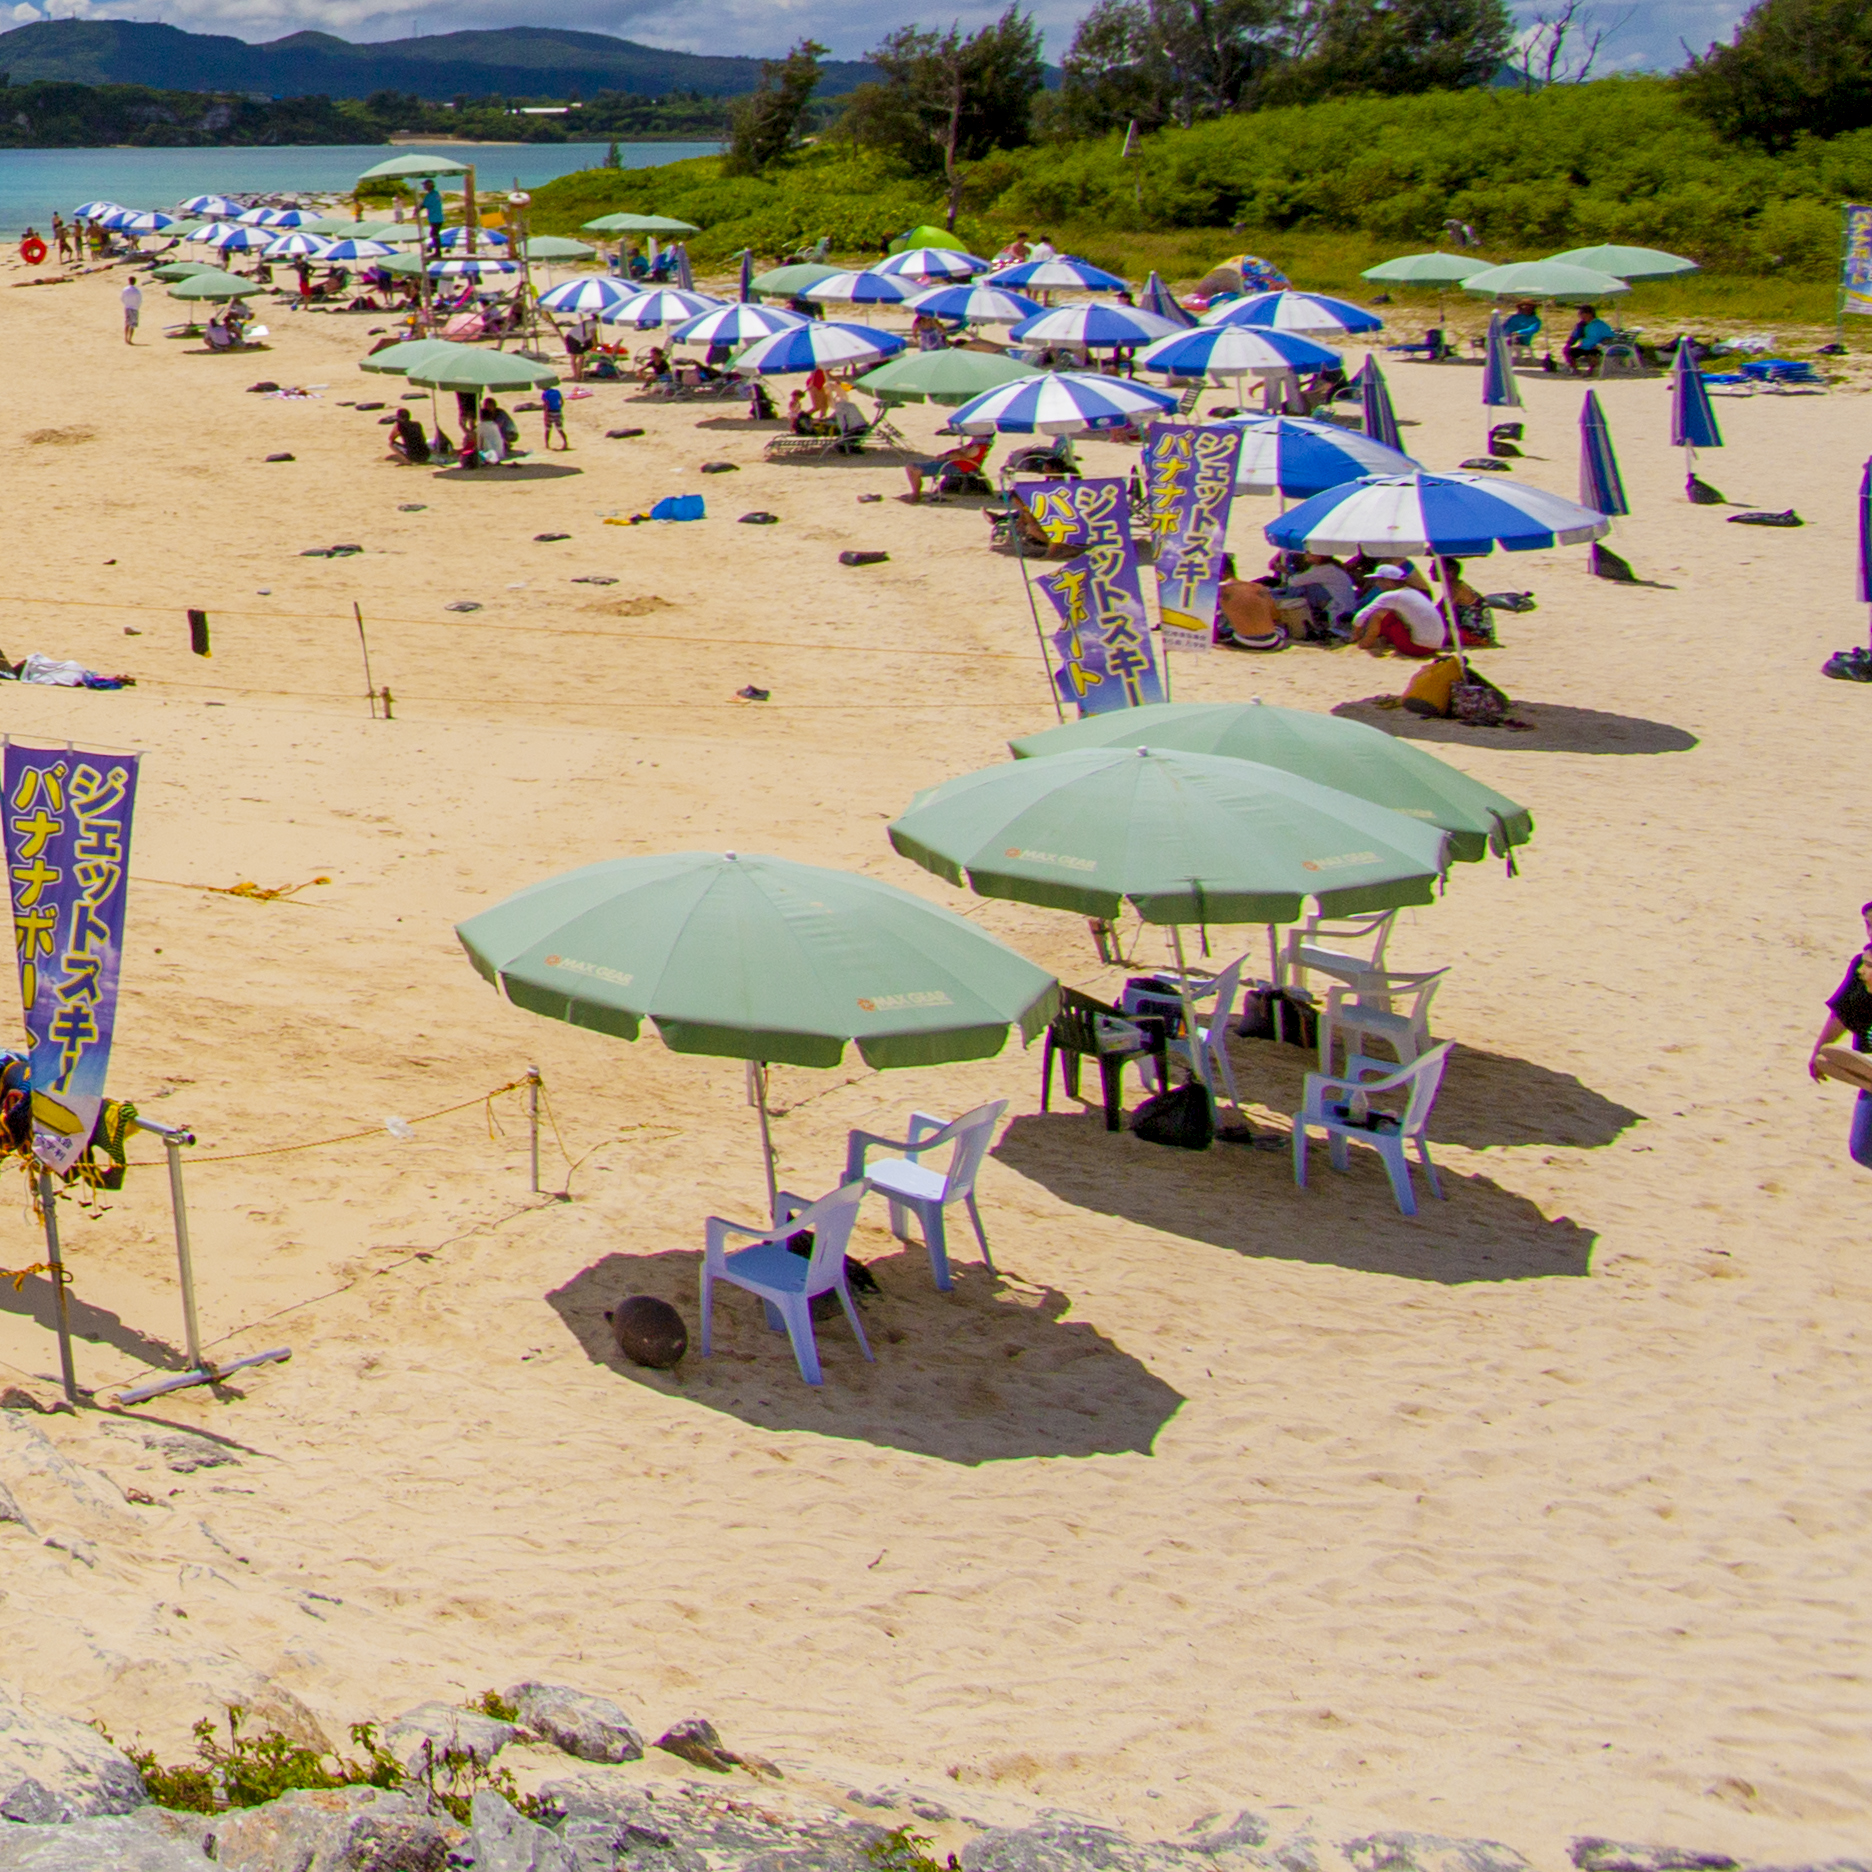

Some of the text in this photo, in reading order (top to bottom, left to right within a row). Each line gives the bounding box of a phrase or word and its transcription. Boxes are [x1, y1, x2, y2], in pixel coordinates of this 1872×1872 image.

[1074, 483, 1148, 708] ジェットスキー
[1151, 430, 1195, 582] バナナボー
[1174, 430, 1237, 610] ジェットスキー
[52, 763, 129, 1097] ジェットスキー
[558, 958, 634, 986] MAX GEAR
